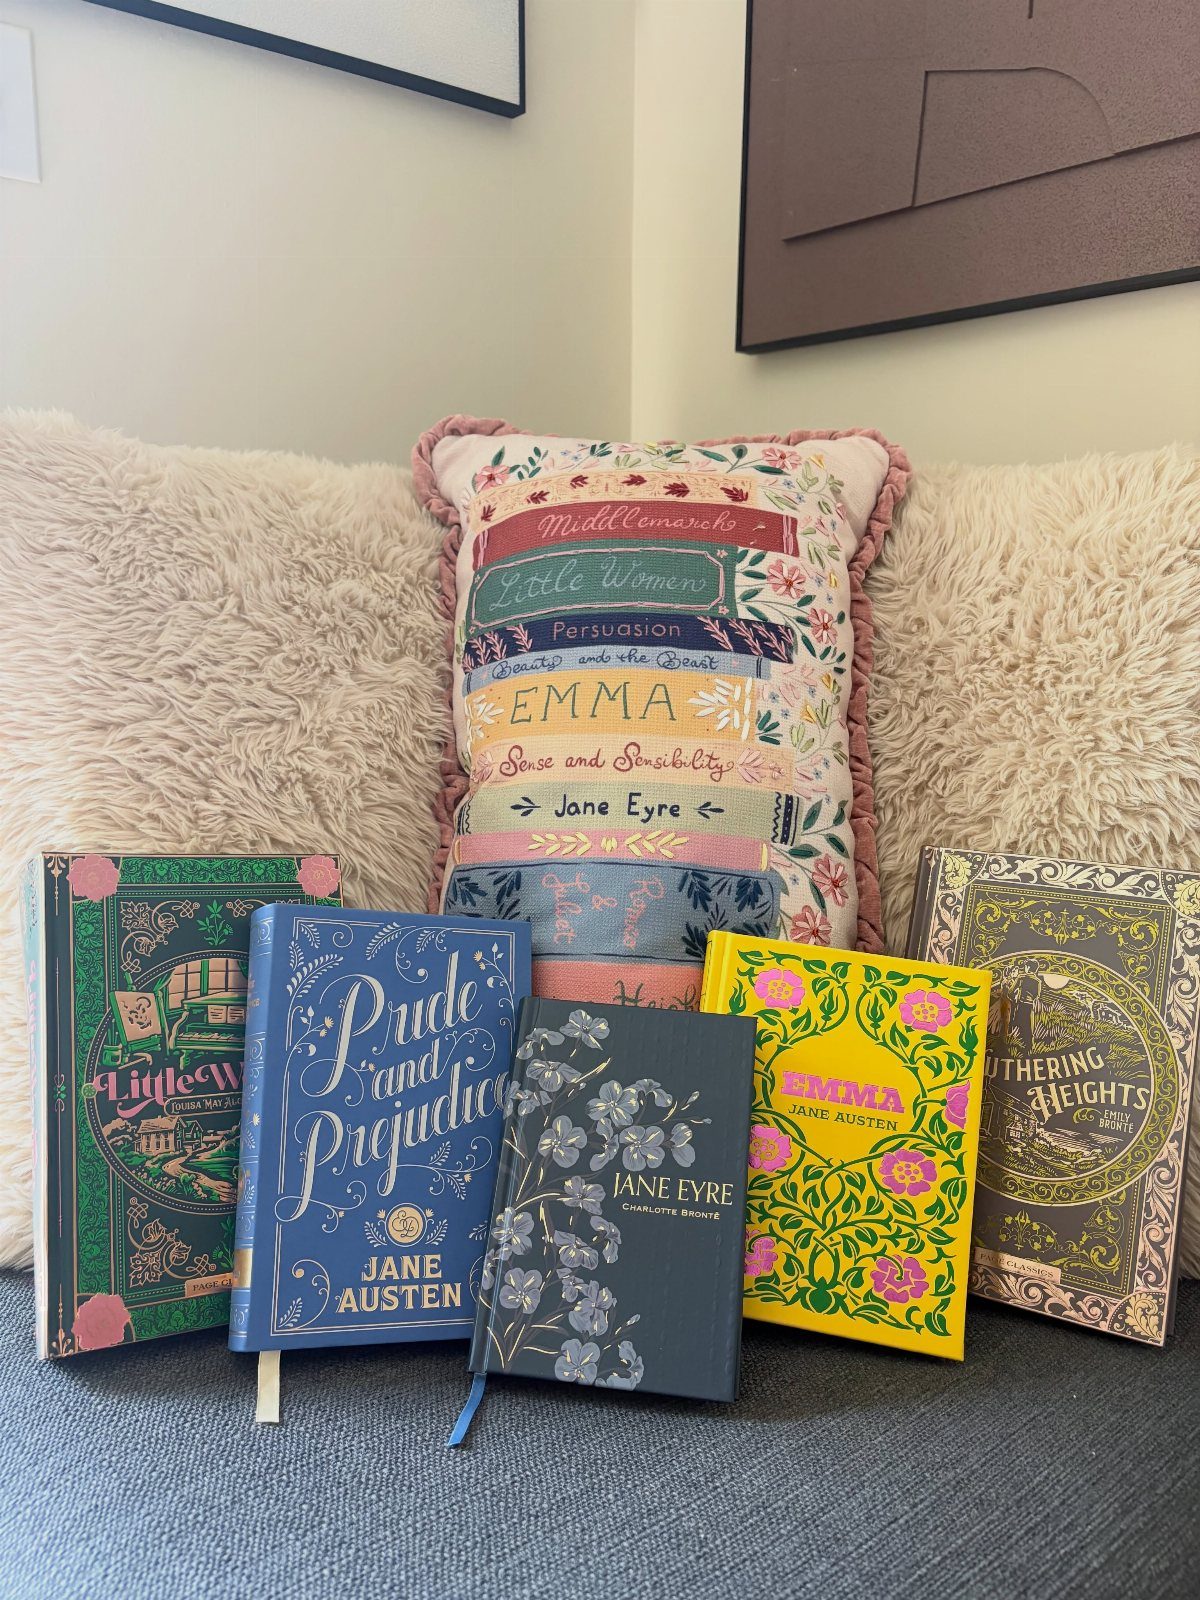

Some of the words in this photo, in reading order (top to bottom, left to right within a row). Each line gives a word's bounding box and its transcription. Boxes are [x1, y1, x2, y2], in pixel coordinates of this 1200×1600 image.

[537, 504, 737, 539] Middlemarch
[489, 558, 583, 611] Little
[600, 556, 707, 593] Women
[552, 621, 681, 641] Persuasion
[491, 655, 563, 680] Beauty
[578, 649, 611, 665] and
[616, 648, 650, 663] the
[656, 650, 719, 670] Beast
[510, 681, 677, 725] EMMA
[499, 744, 555, 777] Sense
[565, 747, 606, 769] and
[612, 741, 735, 783] Sensibility
[554, 793, 610, 818] Jane
[627, 792, 681, 823] Eyre
[301, 950, 483, 1098] Pride
[371, 1036, 452, 1101] and
[985, 1046, 1105, 1082] UTHERING
[92, 1067, 195, 1118] Little
[171, 1101, 202, 1114] LOUISA
[203, 1099, 222, 1110] MAY
[780, 1070, 905, 1114] EMMA
[1027, 1081, 1150, 1125] HEIGHTS
[788, 1104, 830, 1121] JANE
[834, 1112, 898, 1132] AUSTEN
[1103, 1109, 1131, 1123] EMILY
[613, 1172, 671, 1199] JANE
[677, 1178, 734, 1206] EYRE
[622, 1202, 678, 1216] CHARLOTTE
[361, 1253, 442, 1282] JANE
[1006, 1260, 1054, 1278] CLASSICS
[193, 1281, 219, 1292] PAGE
[334, 1282, 462, 1314] AUSTEN
